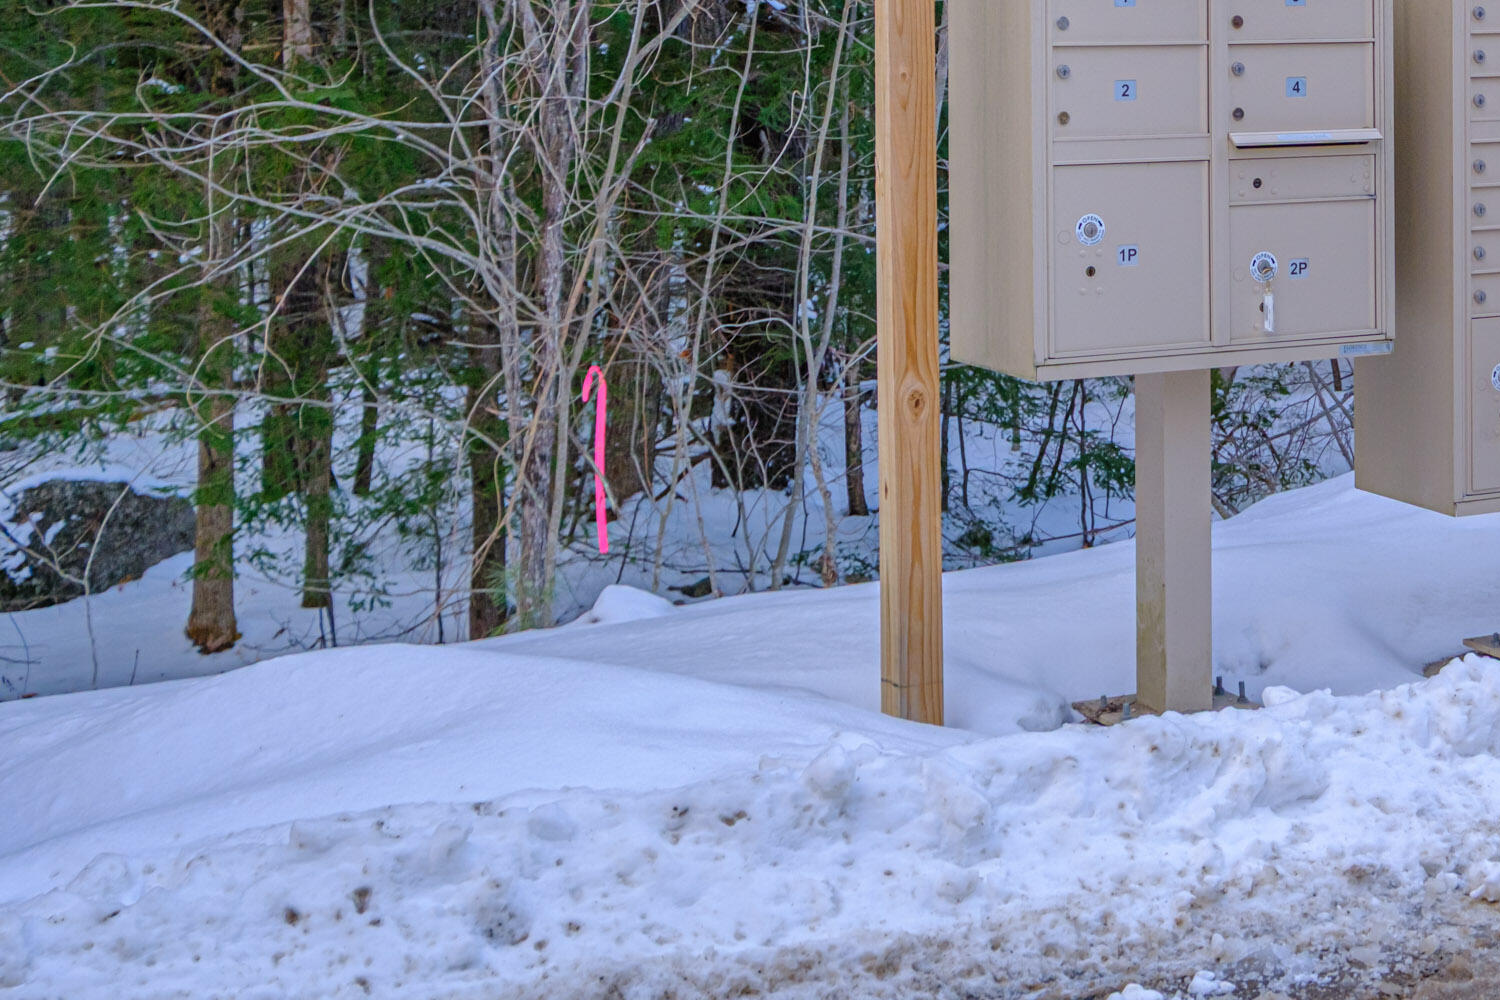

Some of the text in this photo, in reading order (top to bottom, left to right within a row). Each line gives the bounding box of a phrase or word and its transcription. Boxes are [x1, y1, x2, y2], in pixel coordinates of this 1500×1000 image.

[1120, 83, 1131, 97] 2
[1291, 80, 1302, 94] 4
[1082, 215, 1099, 224] OPEN
[1119, 248, 1138, 262] 1P
[1255, 252, 1272, 261] OPEN
[1289, 261, 1308, 276] 2P
